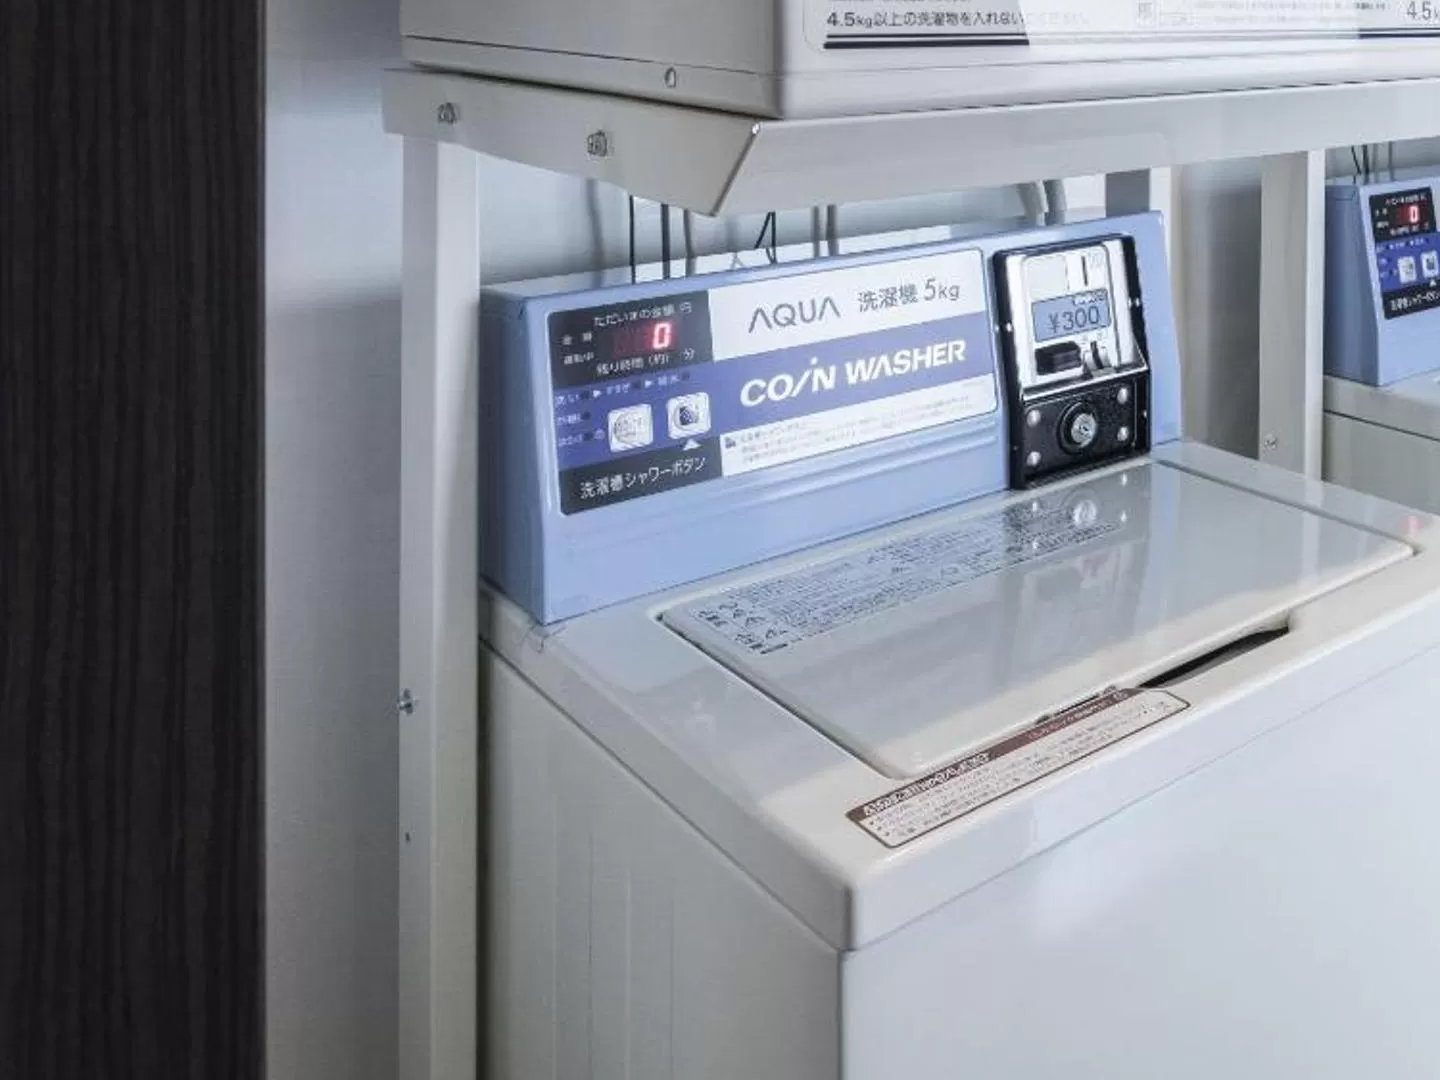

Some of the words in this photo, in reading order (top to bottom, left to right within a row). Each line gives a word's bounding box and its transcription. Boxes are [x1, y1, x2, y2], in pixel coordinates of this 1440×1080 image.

[747, 296, 841, 333] AQUA
[857, 283, 919, 312] 洗濯機
[924, 278, 961, 302] 5kg
[1048, 305, 1100, 333] ¥300
[652, 322, 672, 350] 0
[740, 357, 837, 407] COIN
[844, 339, 967, 386] WASHER
[579, 456, 706, 500] 洗濯槽シャワーボタン
